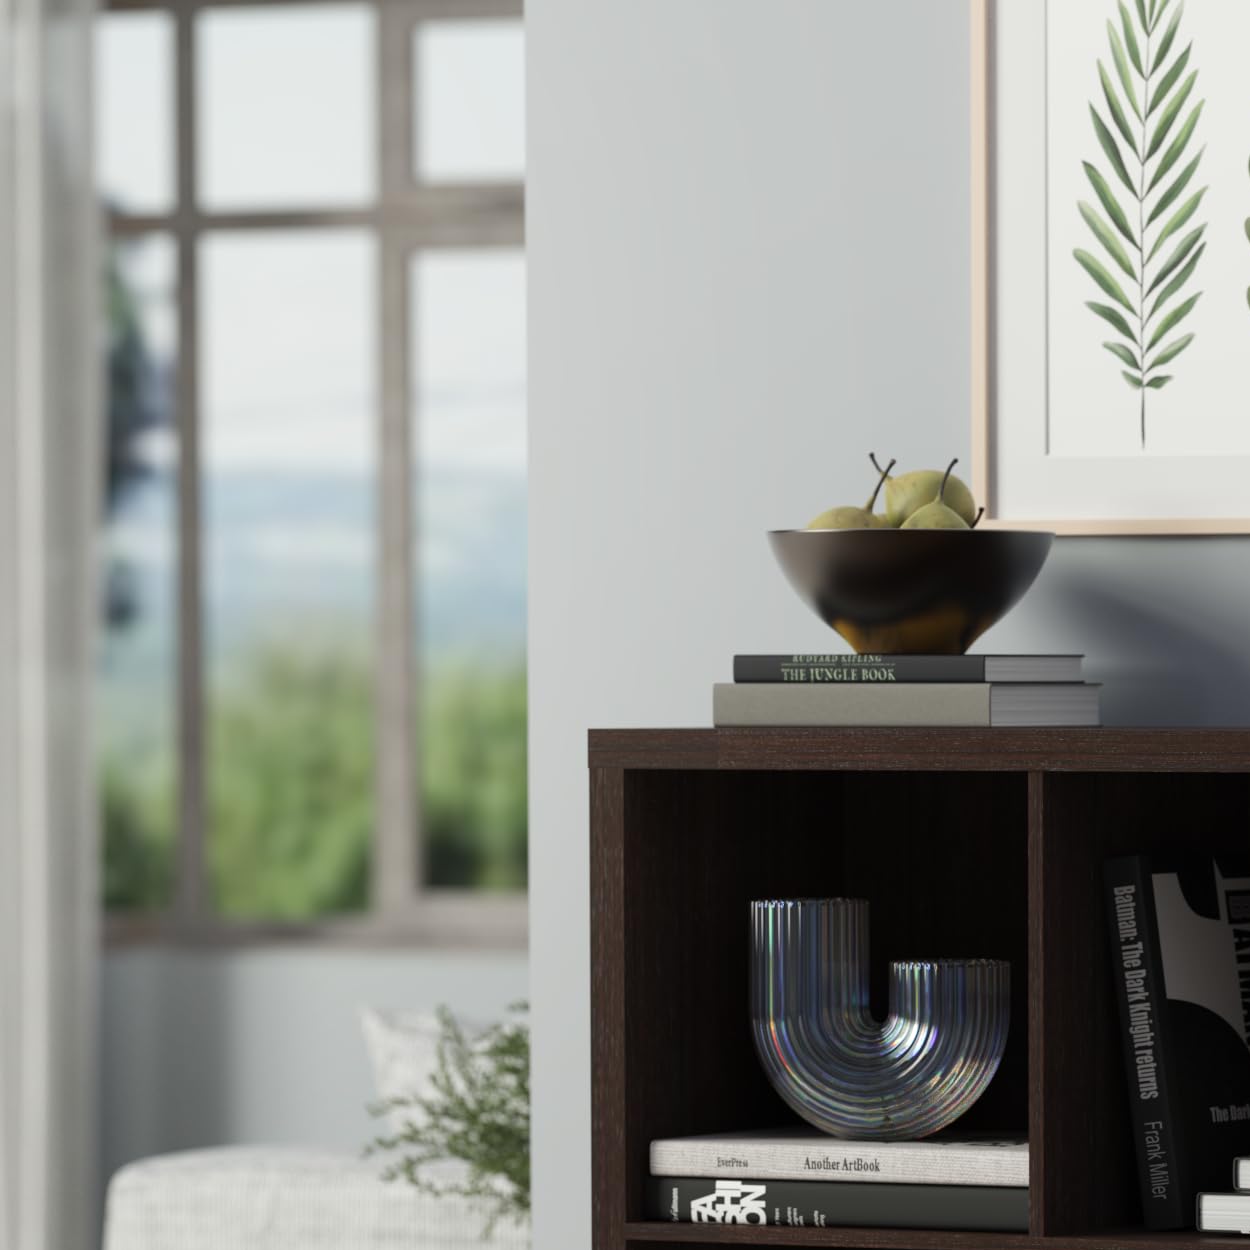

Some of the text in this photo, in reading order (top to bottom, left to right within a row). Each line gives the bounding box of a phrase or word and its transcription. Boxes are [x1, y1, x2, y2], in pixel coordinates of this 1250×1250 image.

[780, 667, 896, 683] THE JUNGLE BOOK
[1113, 884, 1160, 1100] Batman: The Dark Knight returns
[716, 1156, 749, 1168] EverPress
[803, 1156, 881, 1173] Another ArtBook
[1144, 1119, 1170, 1201] Frank Miller
